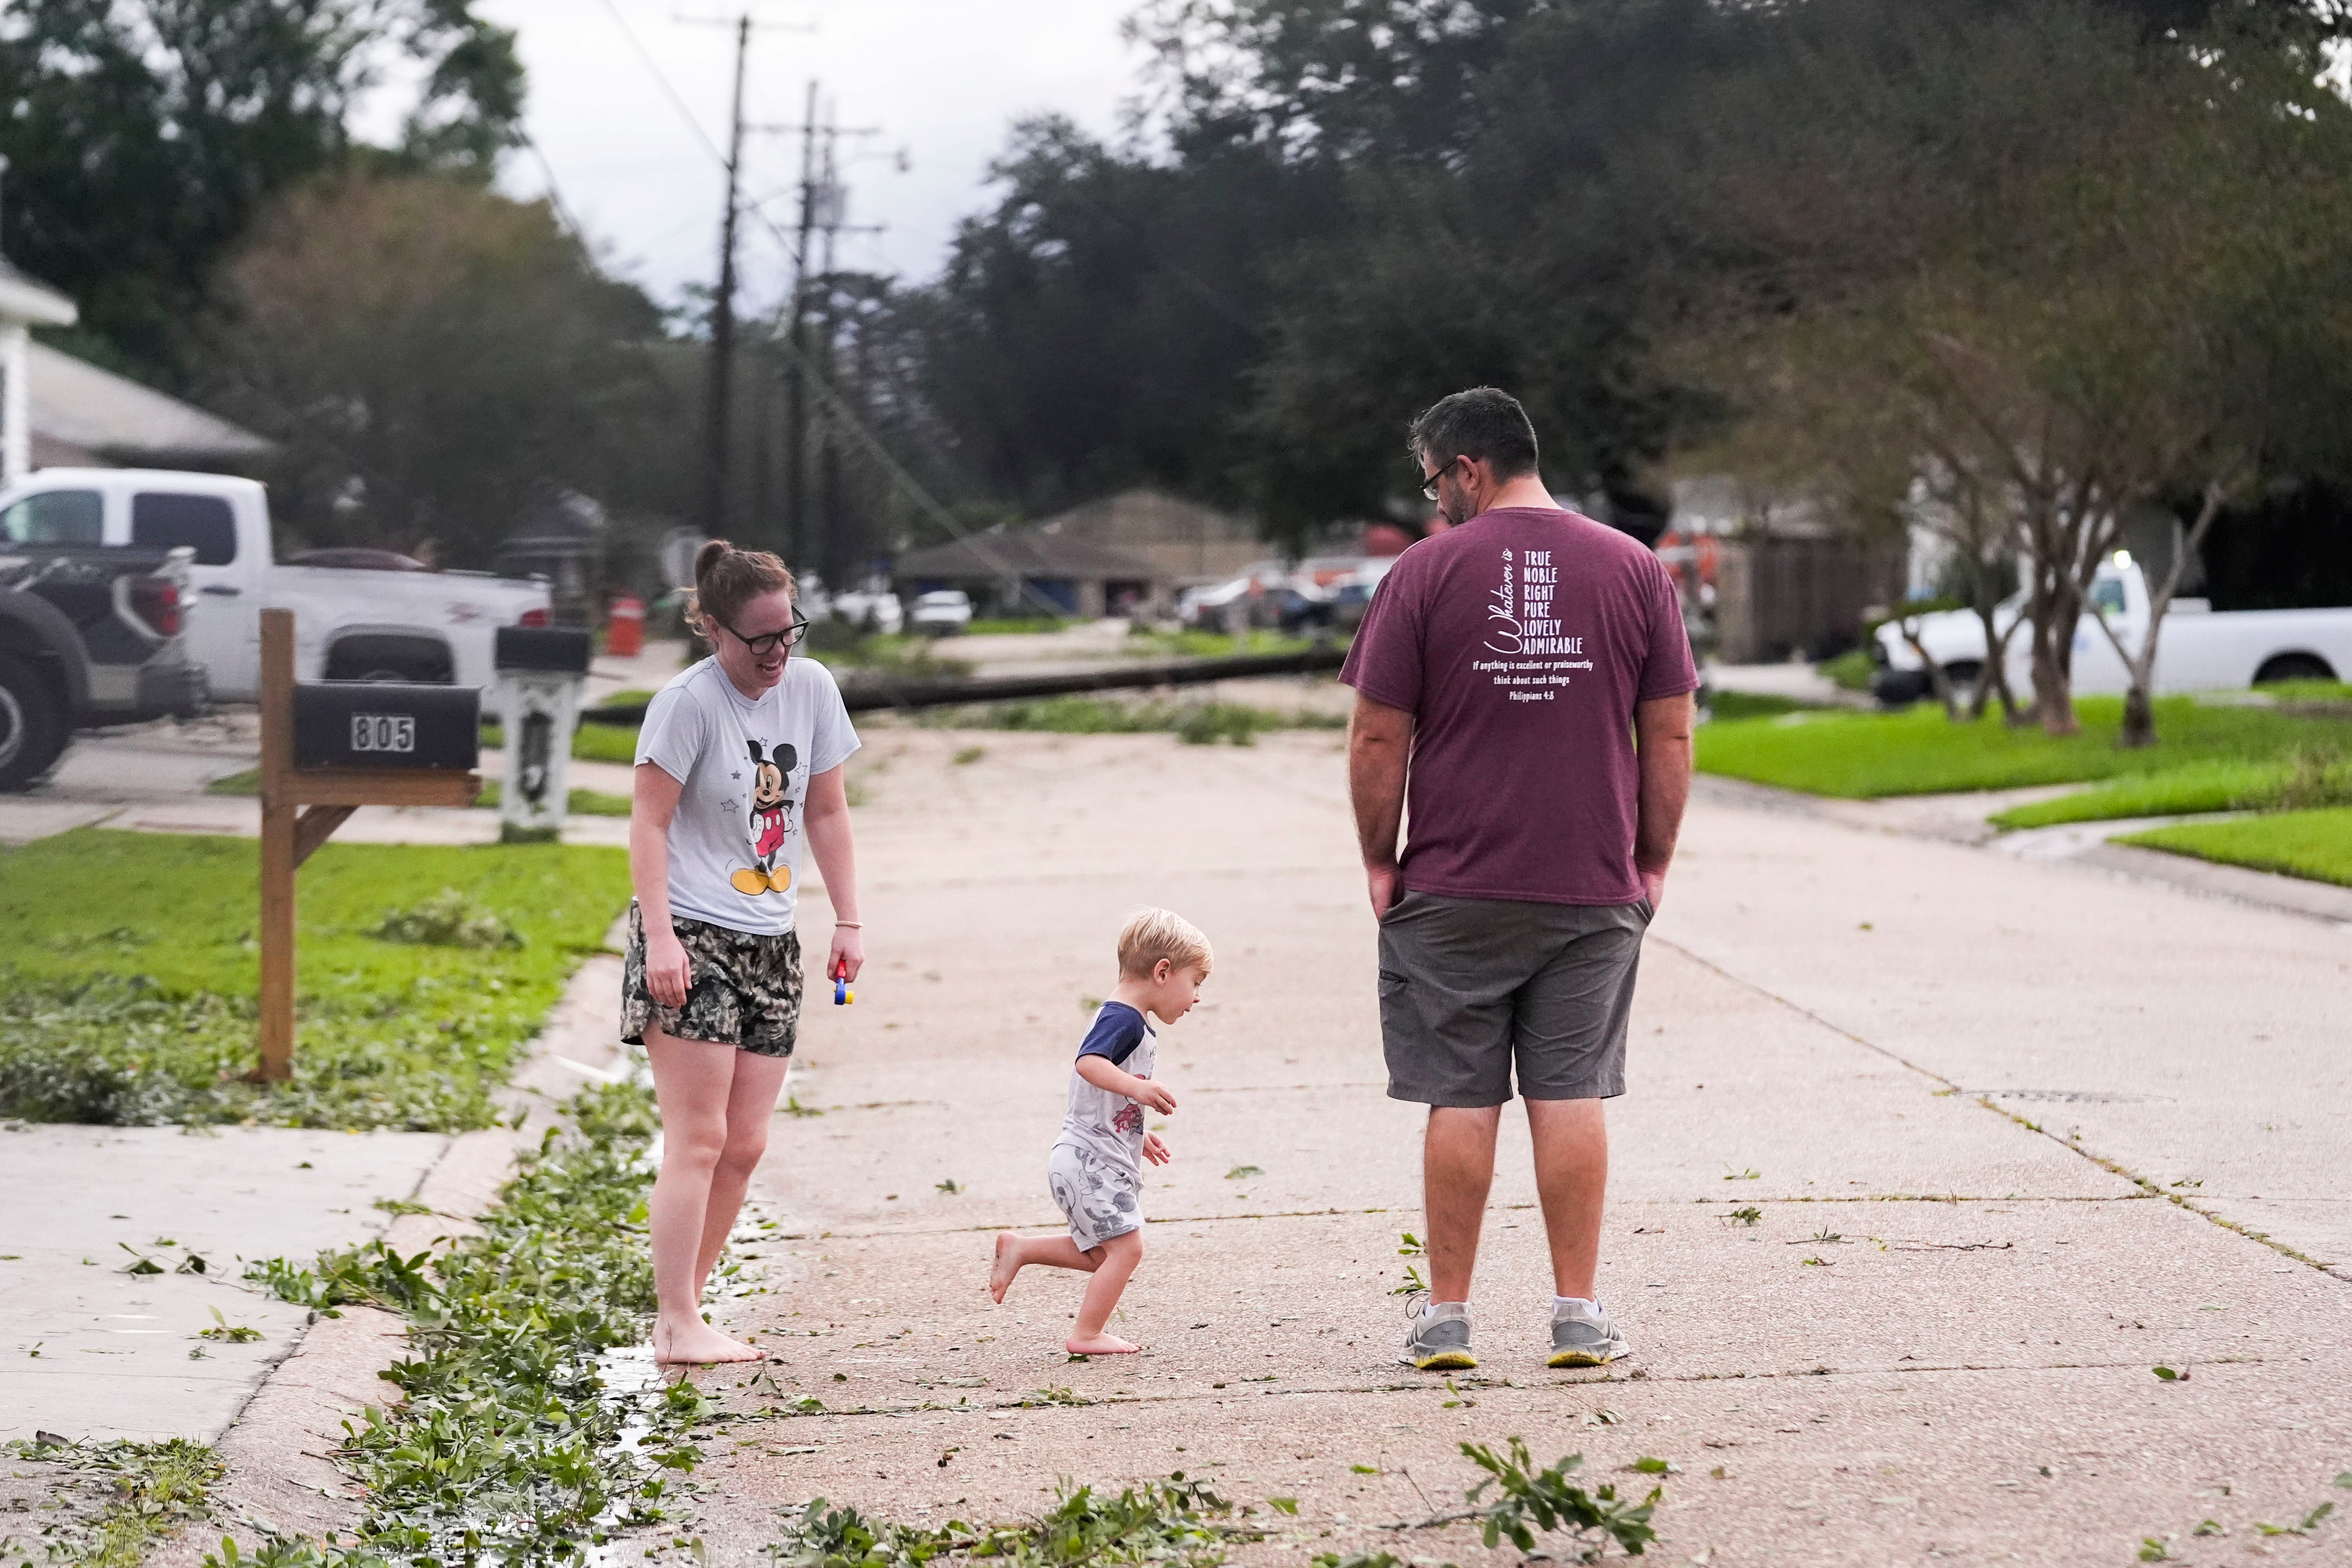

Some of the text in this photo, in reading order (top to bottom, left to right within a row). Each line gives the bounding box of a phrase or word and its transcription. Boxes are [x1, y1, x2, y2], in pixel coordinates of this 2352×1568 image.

[1524, 551, 1551, 566] TRUE
[1524, 567, 1557, 583] NOBLE
[1524, 585, 1554, 600] RIGHT
[1484, 549, 1523, 654] Whatever is
[1524, 602, 1550, 617] PURE
[1524, 620, 1561, 636] LOVELY
[1523, 637, 1583, 655] ADMIRABLE
[1473, 661, 1479, 670] If
[1480, 660, 1507, 672] anything
[1509, 661, 1515, 669] is
[1516, 660, 1543, 669] excellent
[1553, 659, 1593, 671] praiseworthy
[1494, 675, 1569, 686] think about such things
[1509, 691, 1554, 702] Philippians 4:8
[357, 717, 412, 749] 805
